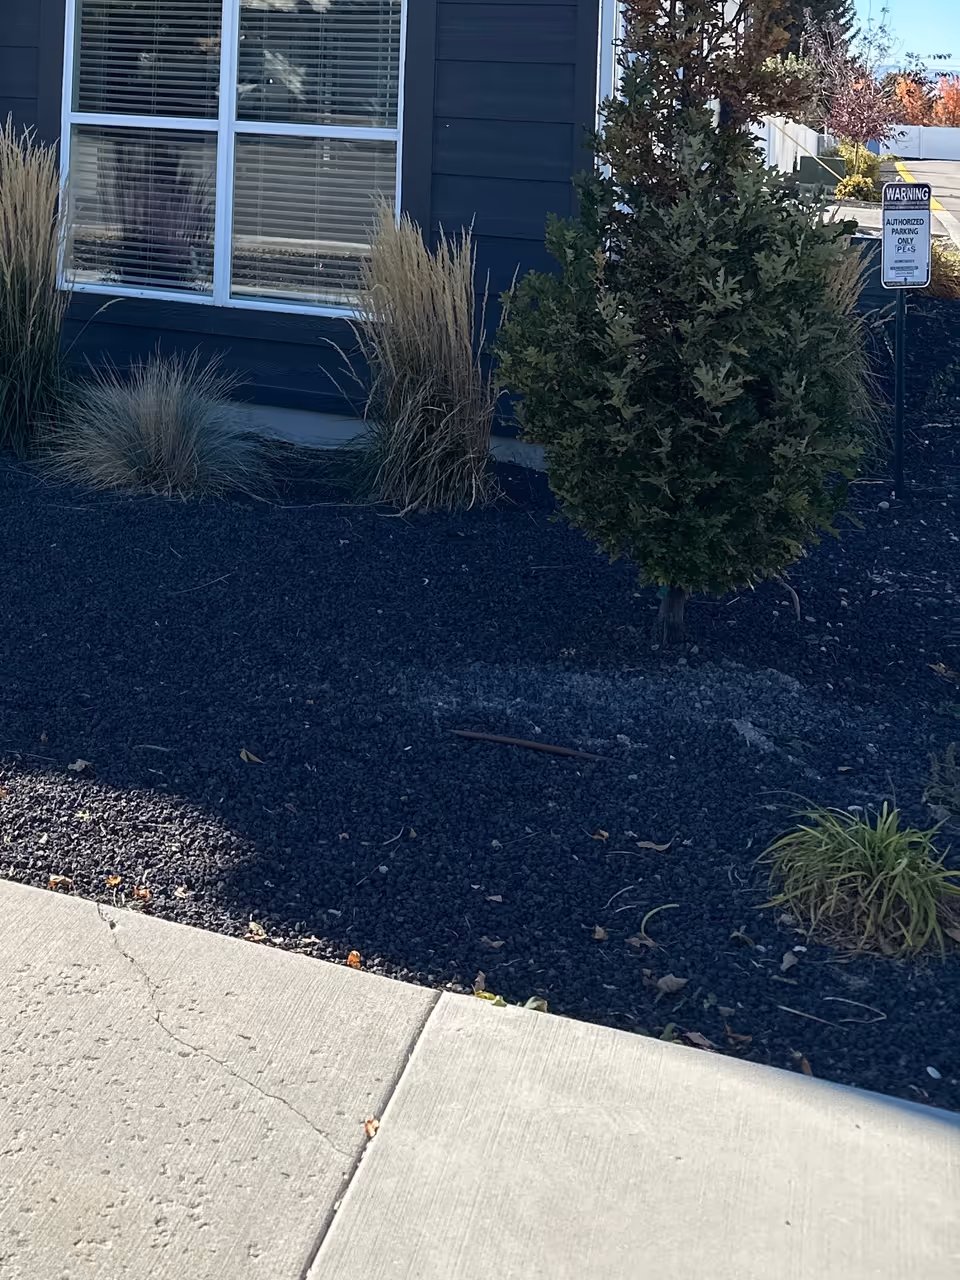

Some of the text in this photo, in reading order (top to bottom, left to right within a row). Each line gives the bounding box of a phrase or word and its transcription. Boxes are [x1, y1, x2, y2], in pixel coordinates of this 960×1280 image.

[886, 187, 929, 200] WARNING
[886, 218, 925, 226] AUTHORIZED
[891, 227, 919, 235] PARKING
[897, 237, 914, 245] ONLY
